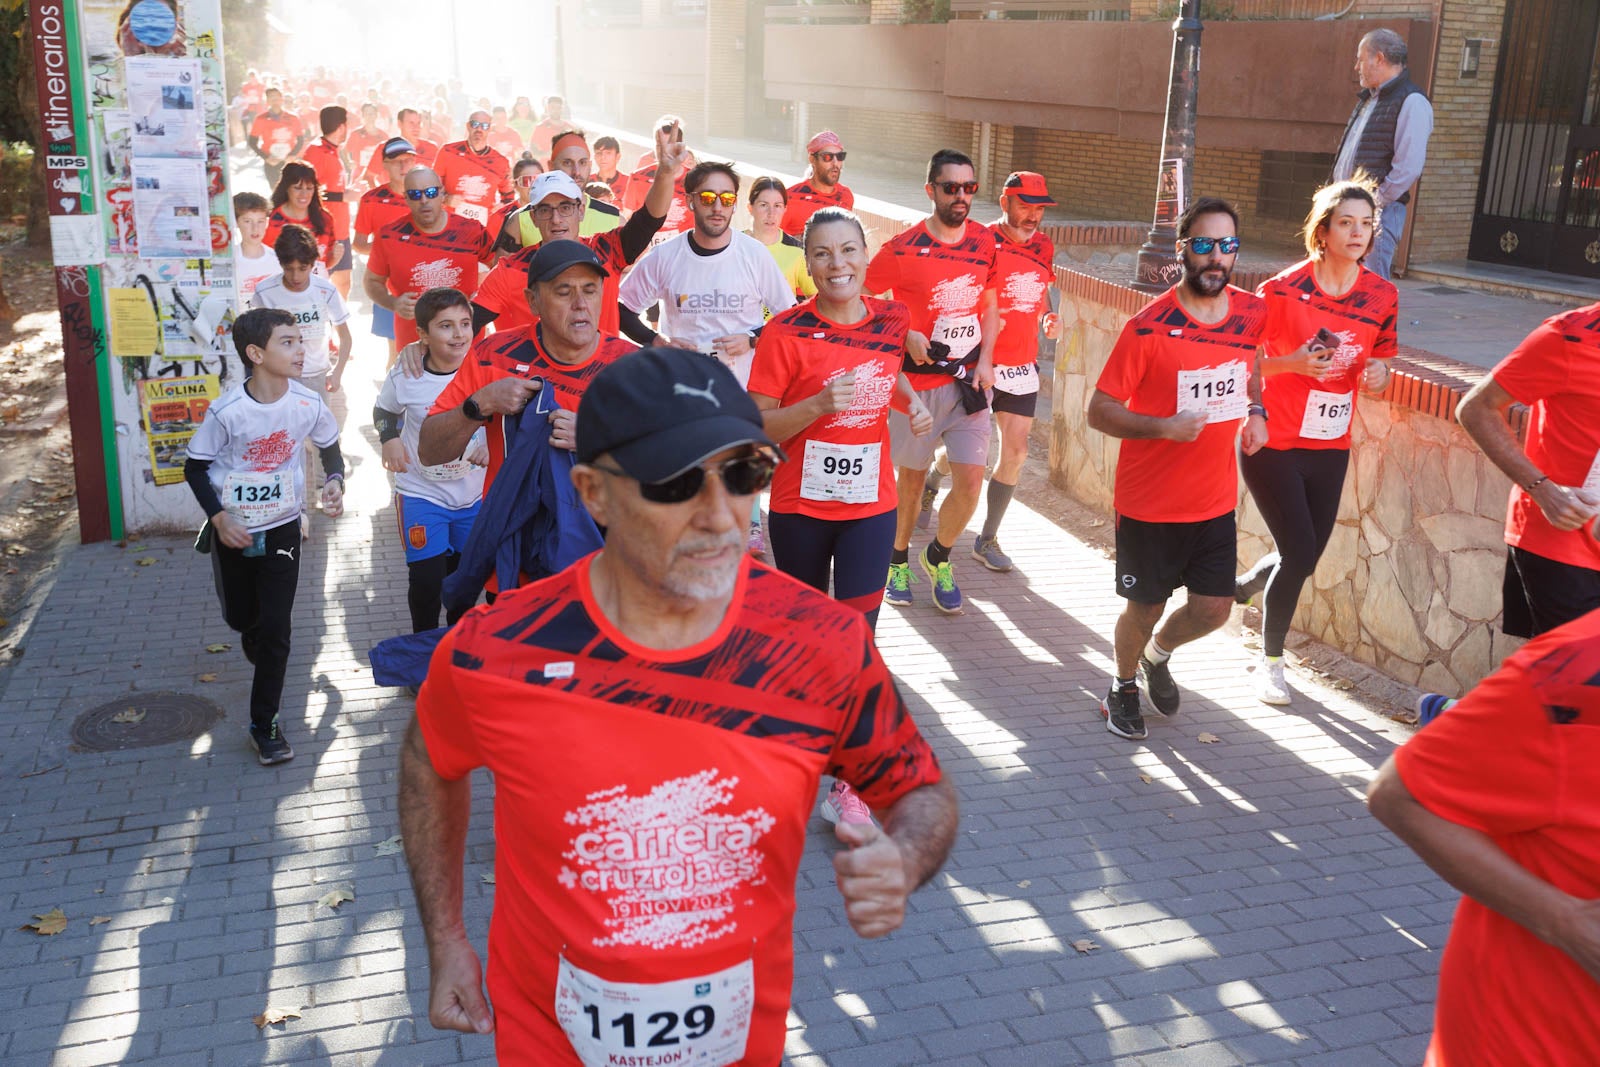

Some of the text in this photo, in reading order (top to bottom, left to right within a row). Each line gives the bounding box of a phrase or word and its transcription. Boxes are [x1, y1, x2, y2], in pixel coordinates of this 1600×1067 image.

[49, 158, 86, 167] MPS
[675, 289, 748, 308] rasher
[294, 310, 320, 324] 364
[943, 325, 975, 340] 1678
[1000, 365, 1029, 380] 1648
[150, 384, 207, 397] MOLINA
[855, 379, 892, 396] rera
[1190, 378, 1235, 399] 1192
[1317, 402, 1351, 418] 1679
[823, 456, 863, 476] 995
[234, 484, 281, 502] 1324
[574, 822, 753, 862] carrera
[580, 856, 756, 892] cruzroja.es
[611, 902, 631, 918] 19
[640, 899, 681, 914] NOV
[584, 1003, 716, 1049] 1129
